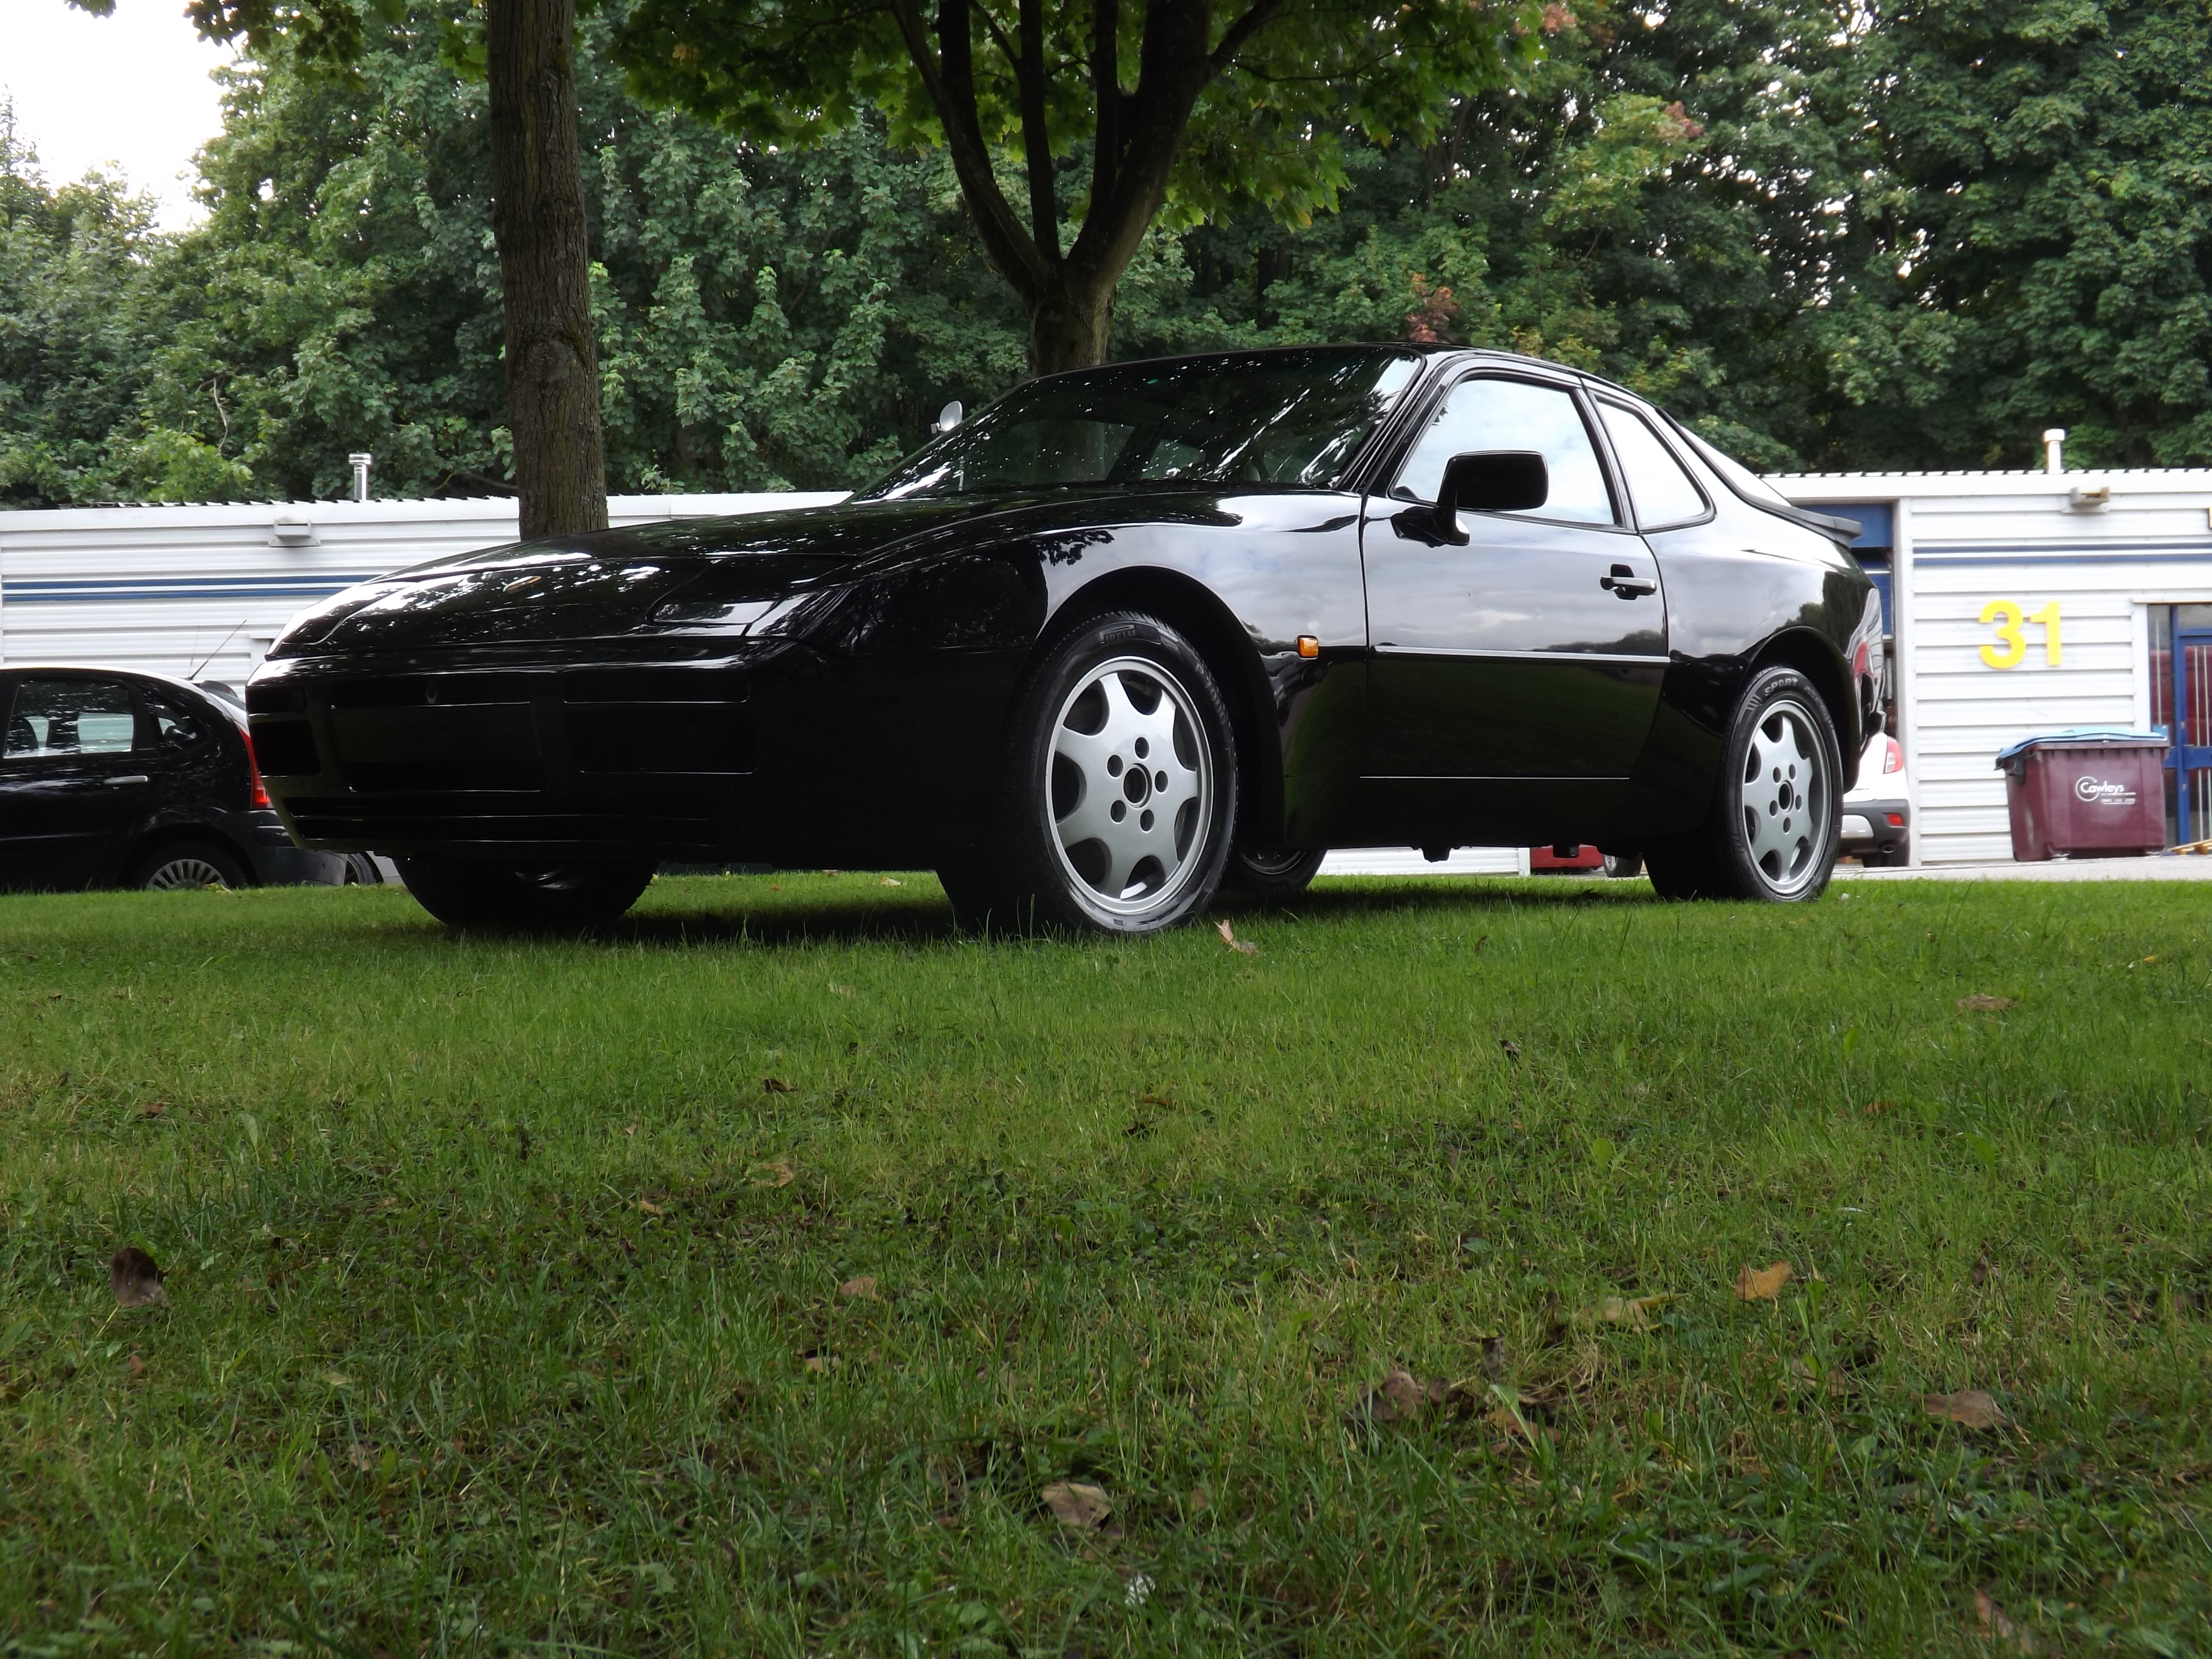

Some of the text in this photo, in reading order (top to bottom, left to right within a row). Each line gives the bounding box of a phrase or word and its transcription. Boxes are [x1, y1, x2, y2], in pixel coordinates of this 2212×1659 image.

[1979, 599, 2062, 669] 31
[1764, 677, 1798, 696] SPORT
[2079, 779, 2125, 795] Cawleys
